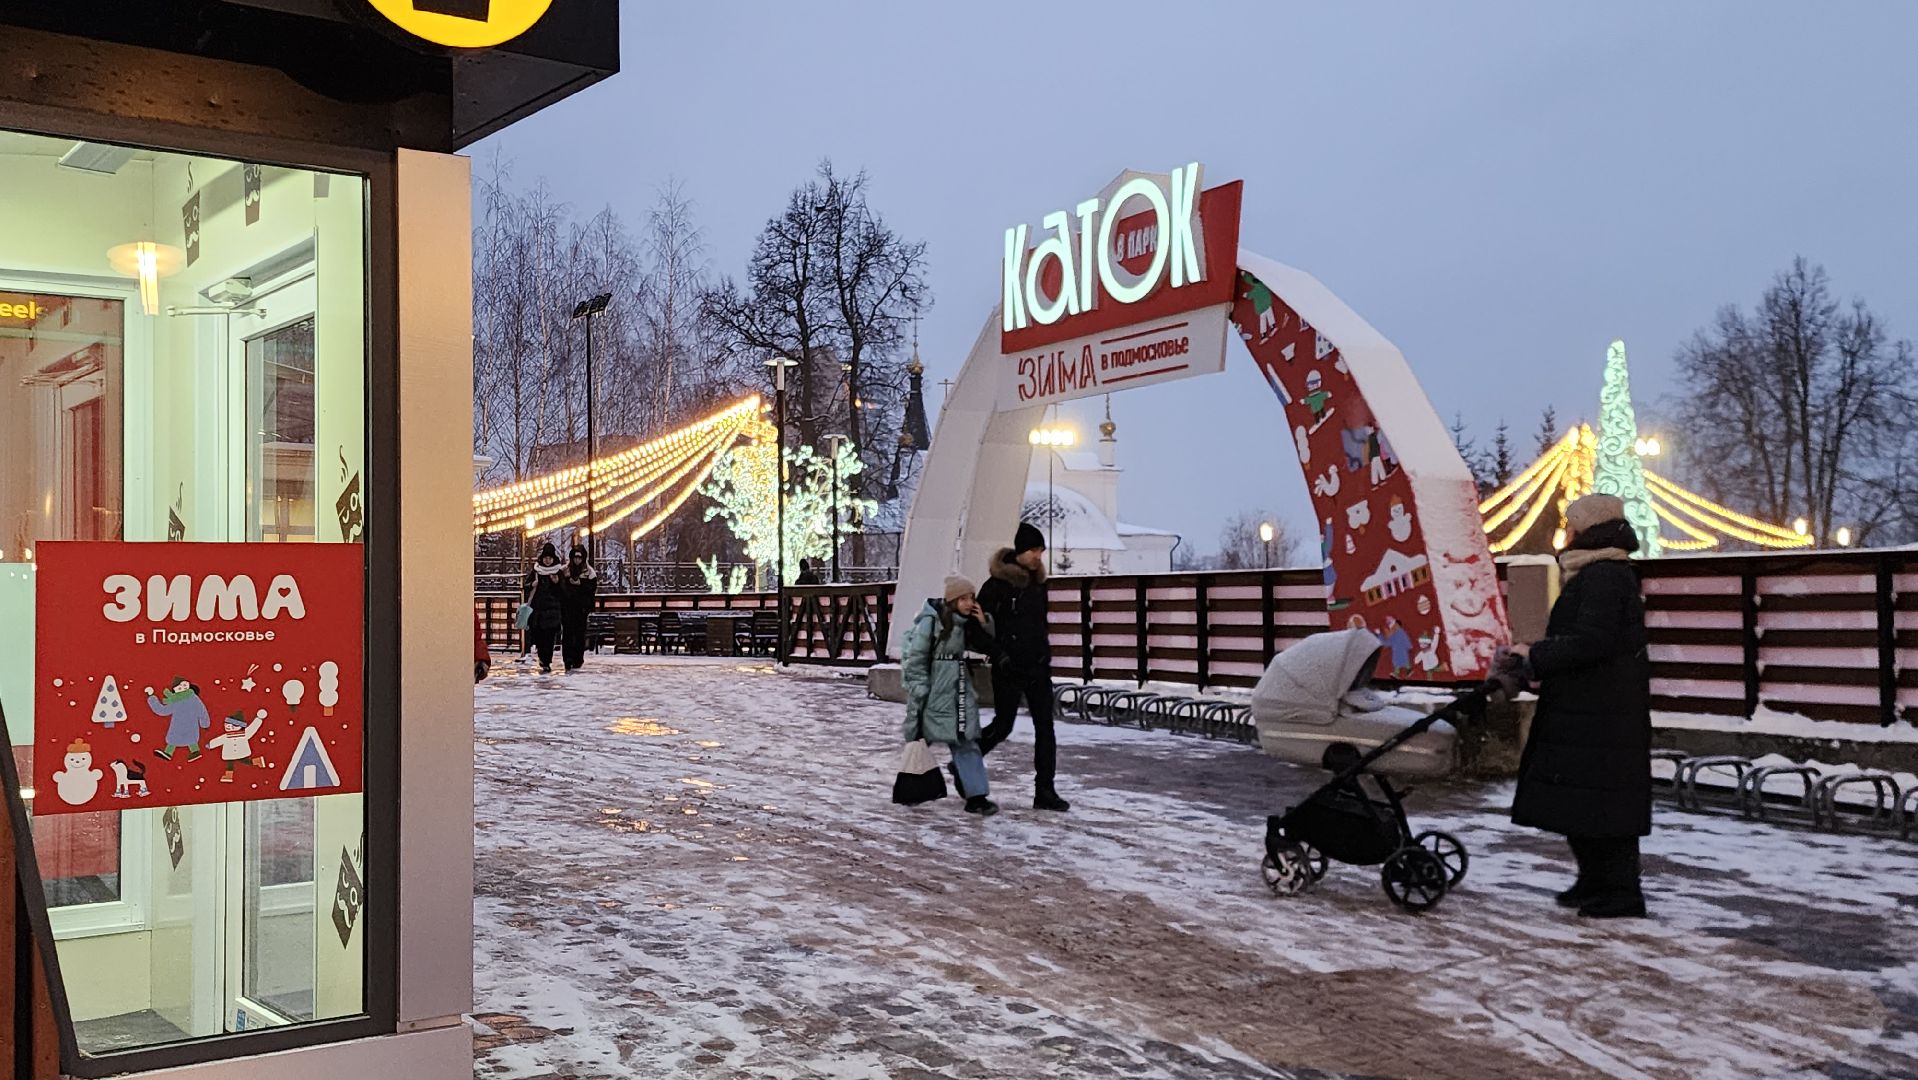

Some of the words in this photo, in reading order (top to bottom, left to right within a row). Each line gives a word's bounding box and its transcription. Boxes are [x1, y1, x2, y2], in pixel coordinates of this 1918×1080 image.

[1018, 344, 1097, 402] ЗИМА
[102, 574, 306, 623] ЗИМА
[135, 632, 146, 644] в
[152, 628, 276, 645] Подмосковье
